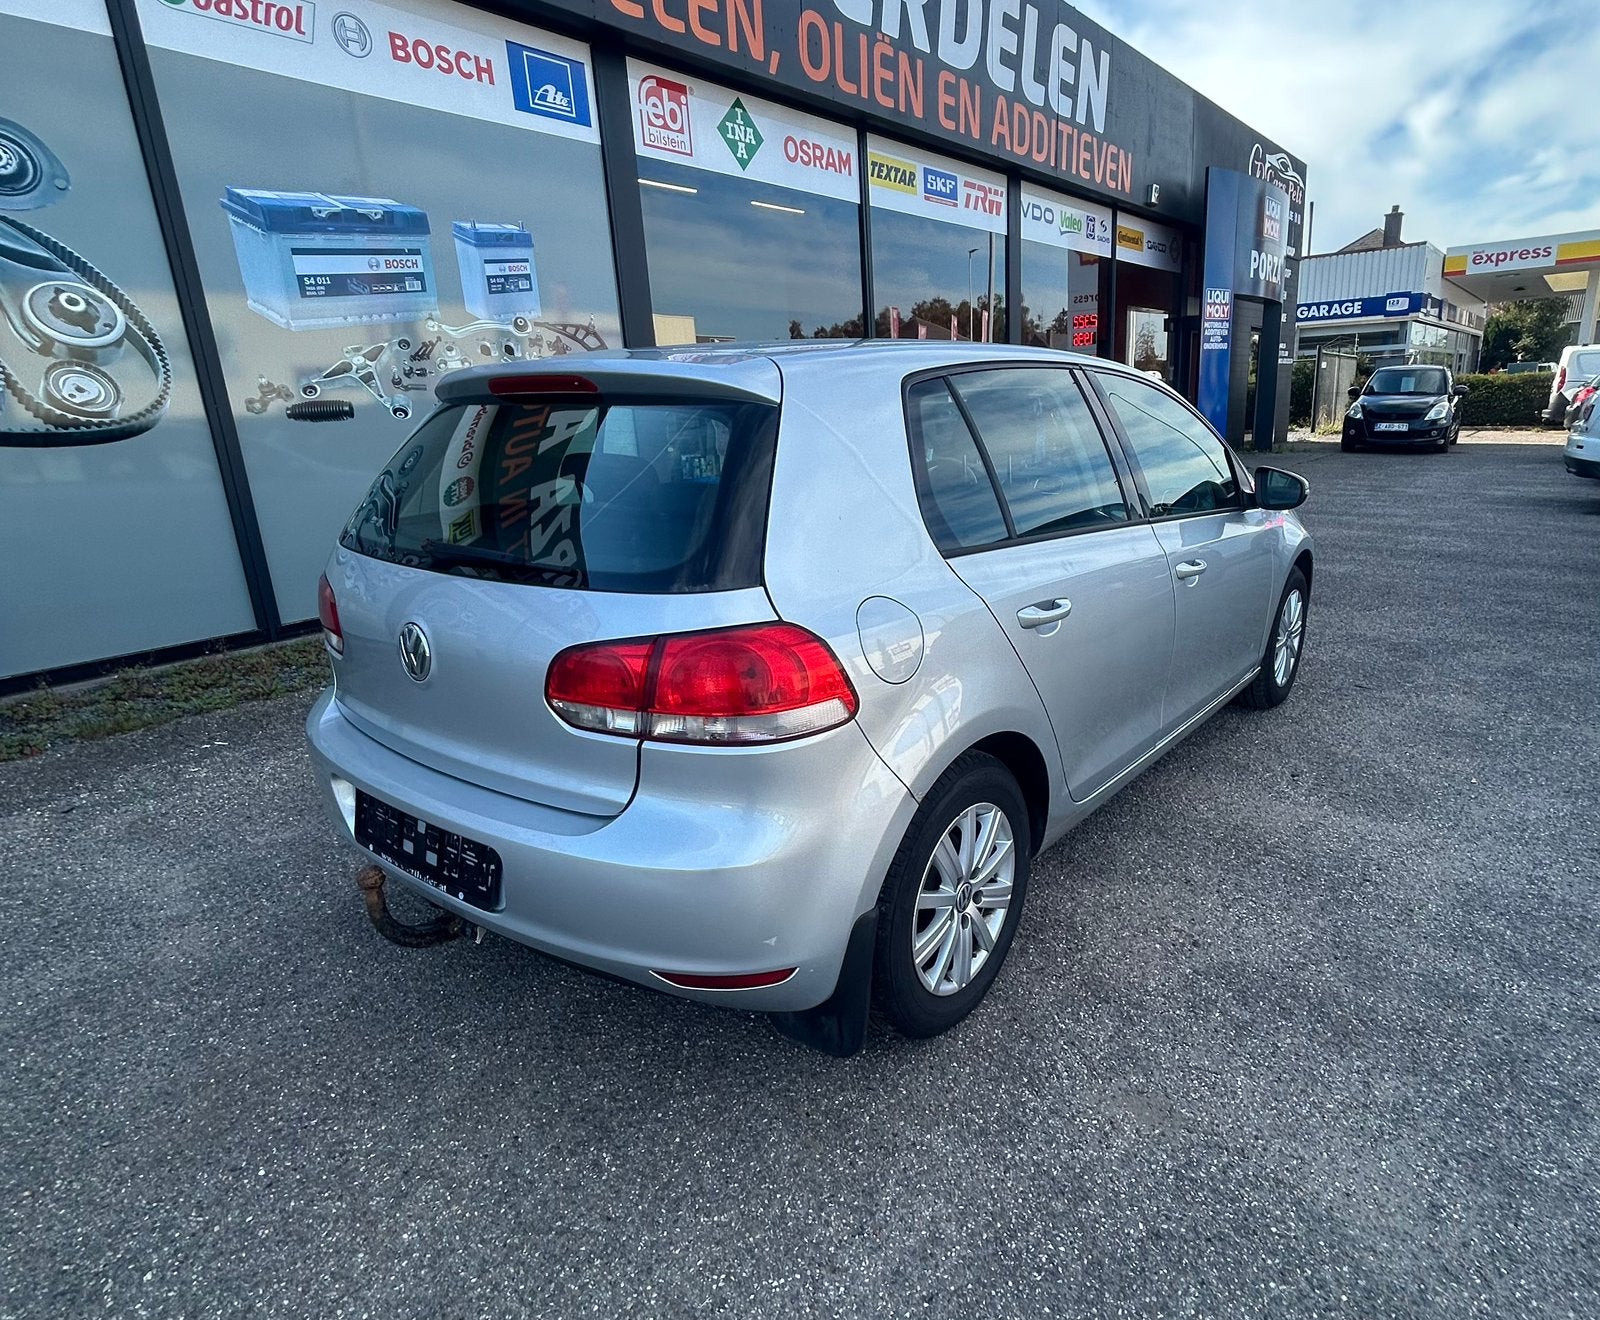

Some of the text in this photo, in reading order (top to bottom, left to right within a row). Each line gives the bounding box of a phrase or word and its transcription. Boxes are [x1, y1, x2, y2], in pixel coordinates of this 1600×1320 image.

[388, 31, 495, 86] BOSCH
[833, 0, 1110, 134] DELEN
[639, 79, 687, 133] febi
[799, 9, 924, 119] OLIËN
[938, 70, 981, 139] EN
[992, 95, 1132, 193] ADDITIEVEN
[648, 128, 687, 151] bilstein
[725, 122, 756, 145] INA
[783, 136, 852, 176] OSRAM
[870, 160, 916, 188] TEXTAR
[927, 175, 956, 194] SKF
[964, 180, 1004, 216] TRW
[1021, 200, 1054, 224] VDO
[1060, 210, 1082, 232] Valeo
[385, 259, 419, 269] BOSCH
[1472, 246, 1552, 266] express
[316, 276, 331, 285] 011
[1207, 290, 1230, 304] LIQUI
[1206, 304, 1229, 318] MOLY
[1297, 301, 1362, 318] GARAGE
